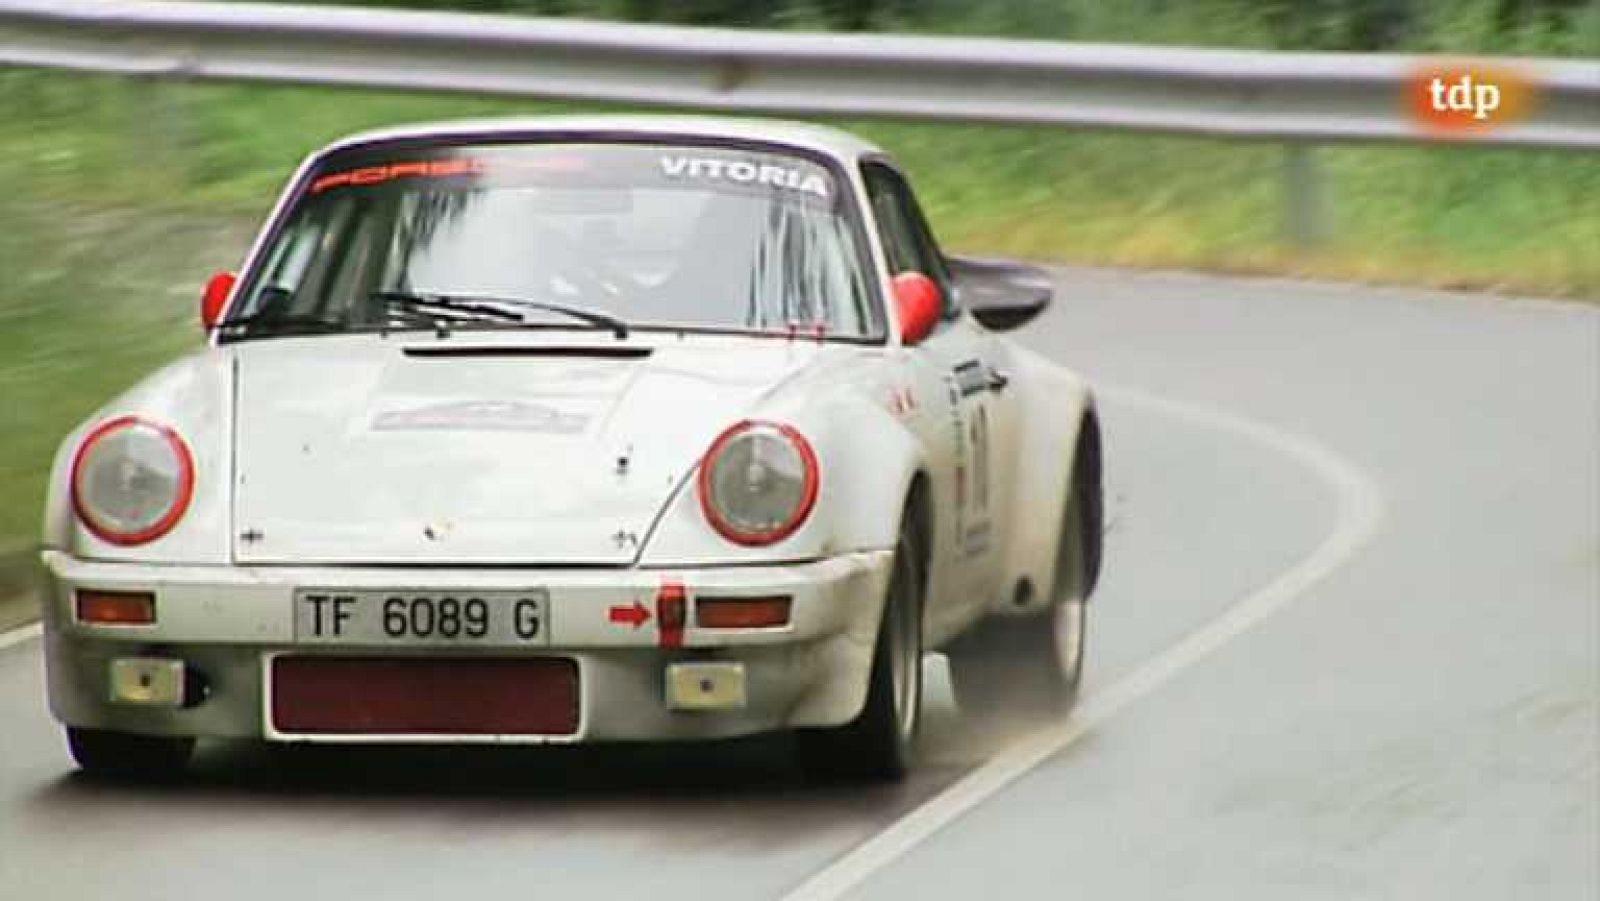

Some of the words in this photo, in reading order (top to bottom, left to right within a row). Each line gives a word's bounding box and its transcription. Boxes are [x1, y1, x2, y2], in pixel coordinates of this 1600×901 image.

[661, 155, 828, 197] VITORIA
[305, 594, 357, 637] TF
[383, 597, 489, 639] 6089
[513, 598, 540, 640] G
